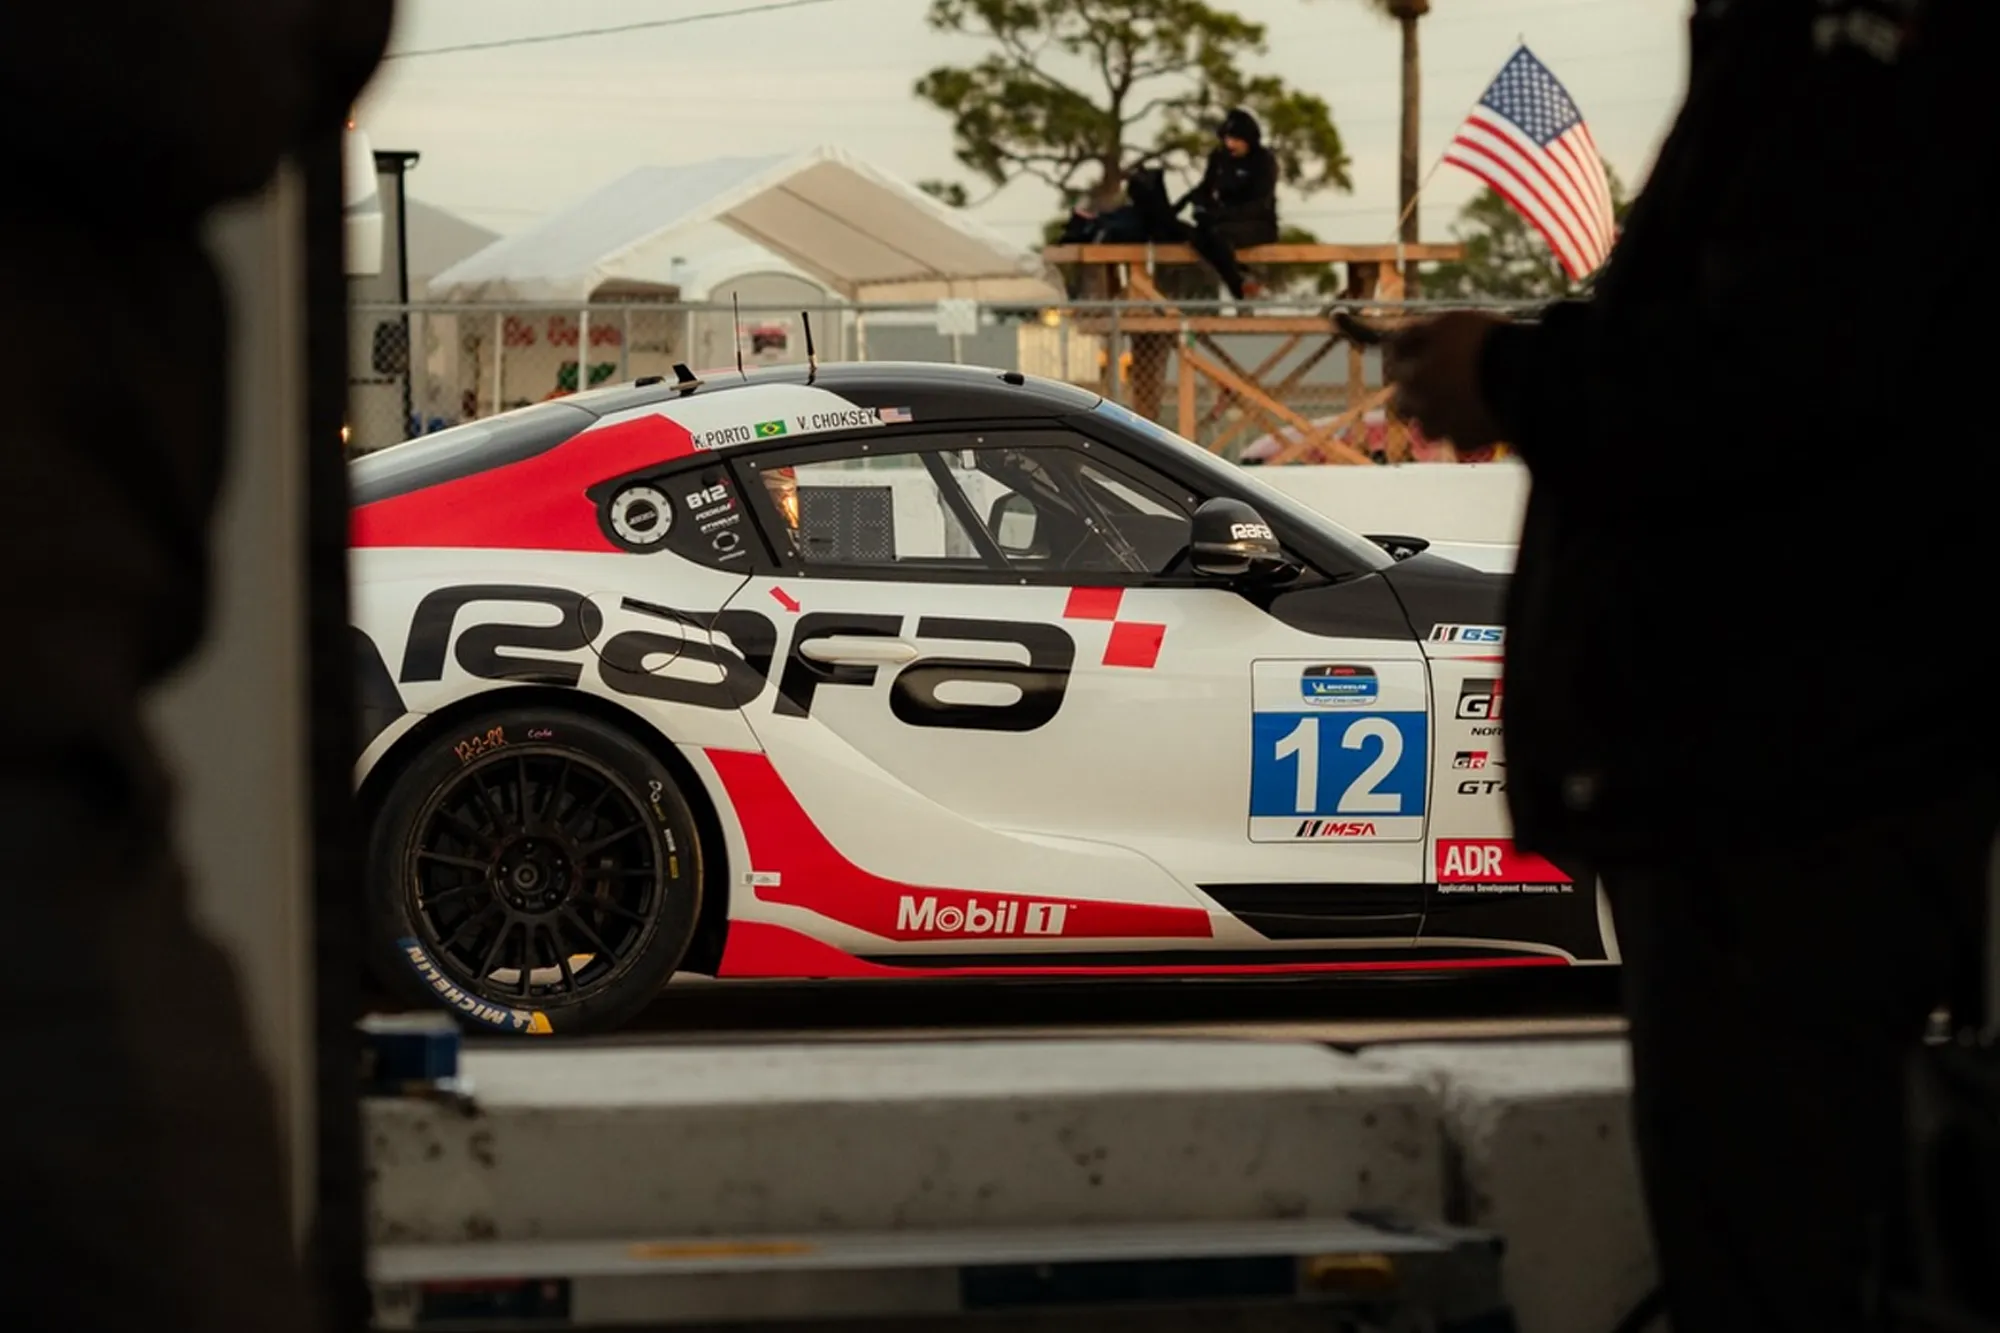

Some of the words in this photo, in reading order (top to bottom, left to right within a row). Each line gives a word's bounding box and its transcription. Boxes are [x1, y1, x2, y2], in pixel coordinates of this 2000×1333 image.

[797, 414, 810, 430] V.
[812, 408, 875, 429] CHOKSEY
[707, 426, 750, 446] PORTO
[1461, 628, 1503, 641] GS
[1275, 717, 1403, 812] 12
[1453, 757, 1487, 769] GR
[1322, 823, 1376, 836] IMSA
[1443, 845, 1503, 876] ADR
[1438, 884, 1475, 893] Application
[1477, 884, 1520, 893] Development
[897, 895, 1019, 934] Mobil
[406, 946, 507, 1025] MICHELIN
